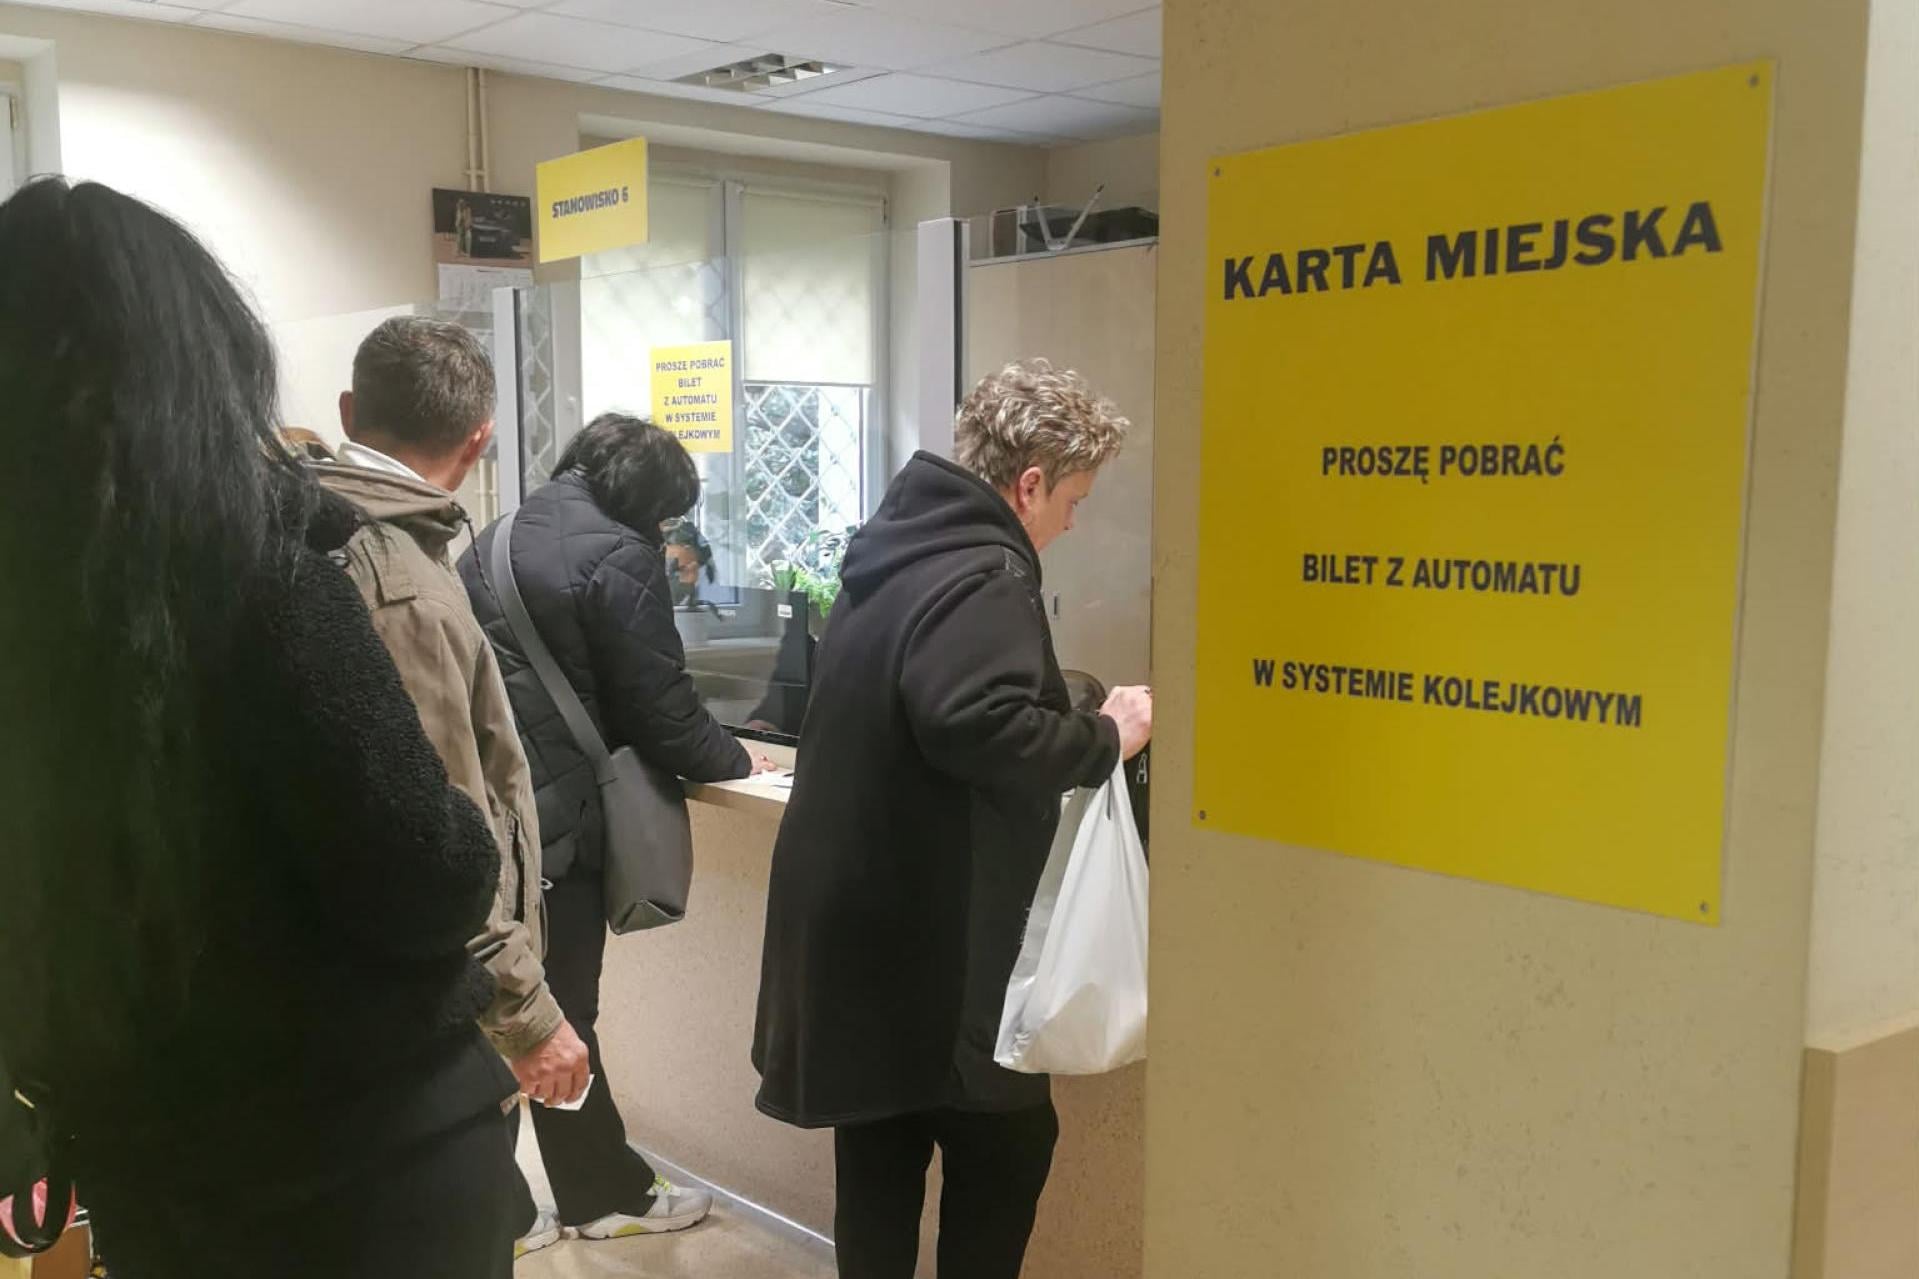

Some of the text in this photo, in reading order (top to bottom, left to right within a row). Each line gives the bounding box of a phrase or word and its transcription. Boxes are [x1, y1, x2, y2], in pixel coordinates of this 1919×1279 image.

[552, 188, 619, 218] STANOWISKO
[1223, 202, 1723, 300] KARTA MIEJSKA
[664, 394, 717, 406] Z AUTOMATU
[678, 377, 701, 388] BILET
[665, 411, 716, 423] W SYSTEMIE
[1322, 436, 1565, 485] PROSZĘ POBRAĆ
[1302, 553, 1582, 596] BILET Z AUTOMATU
[1252, 658, 1643, 728] W SYSTEMIE KOLEJKOWYM
